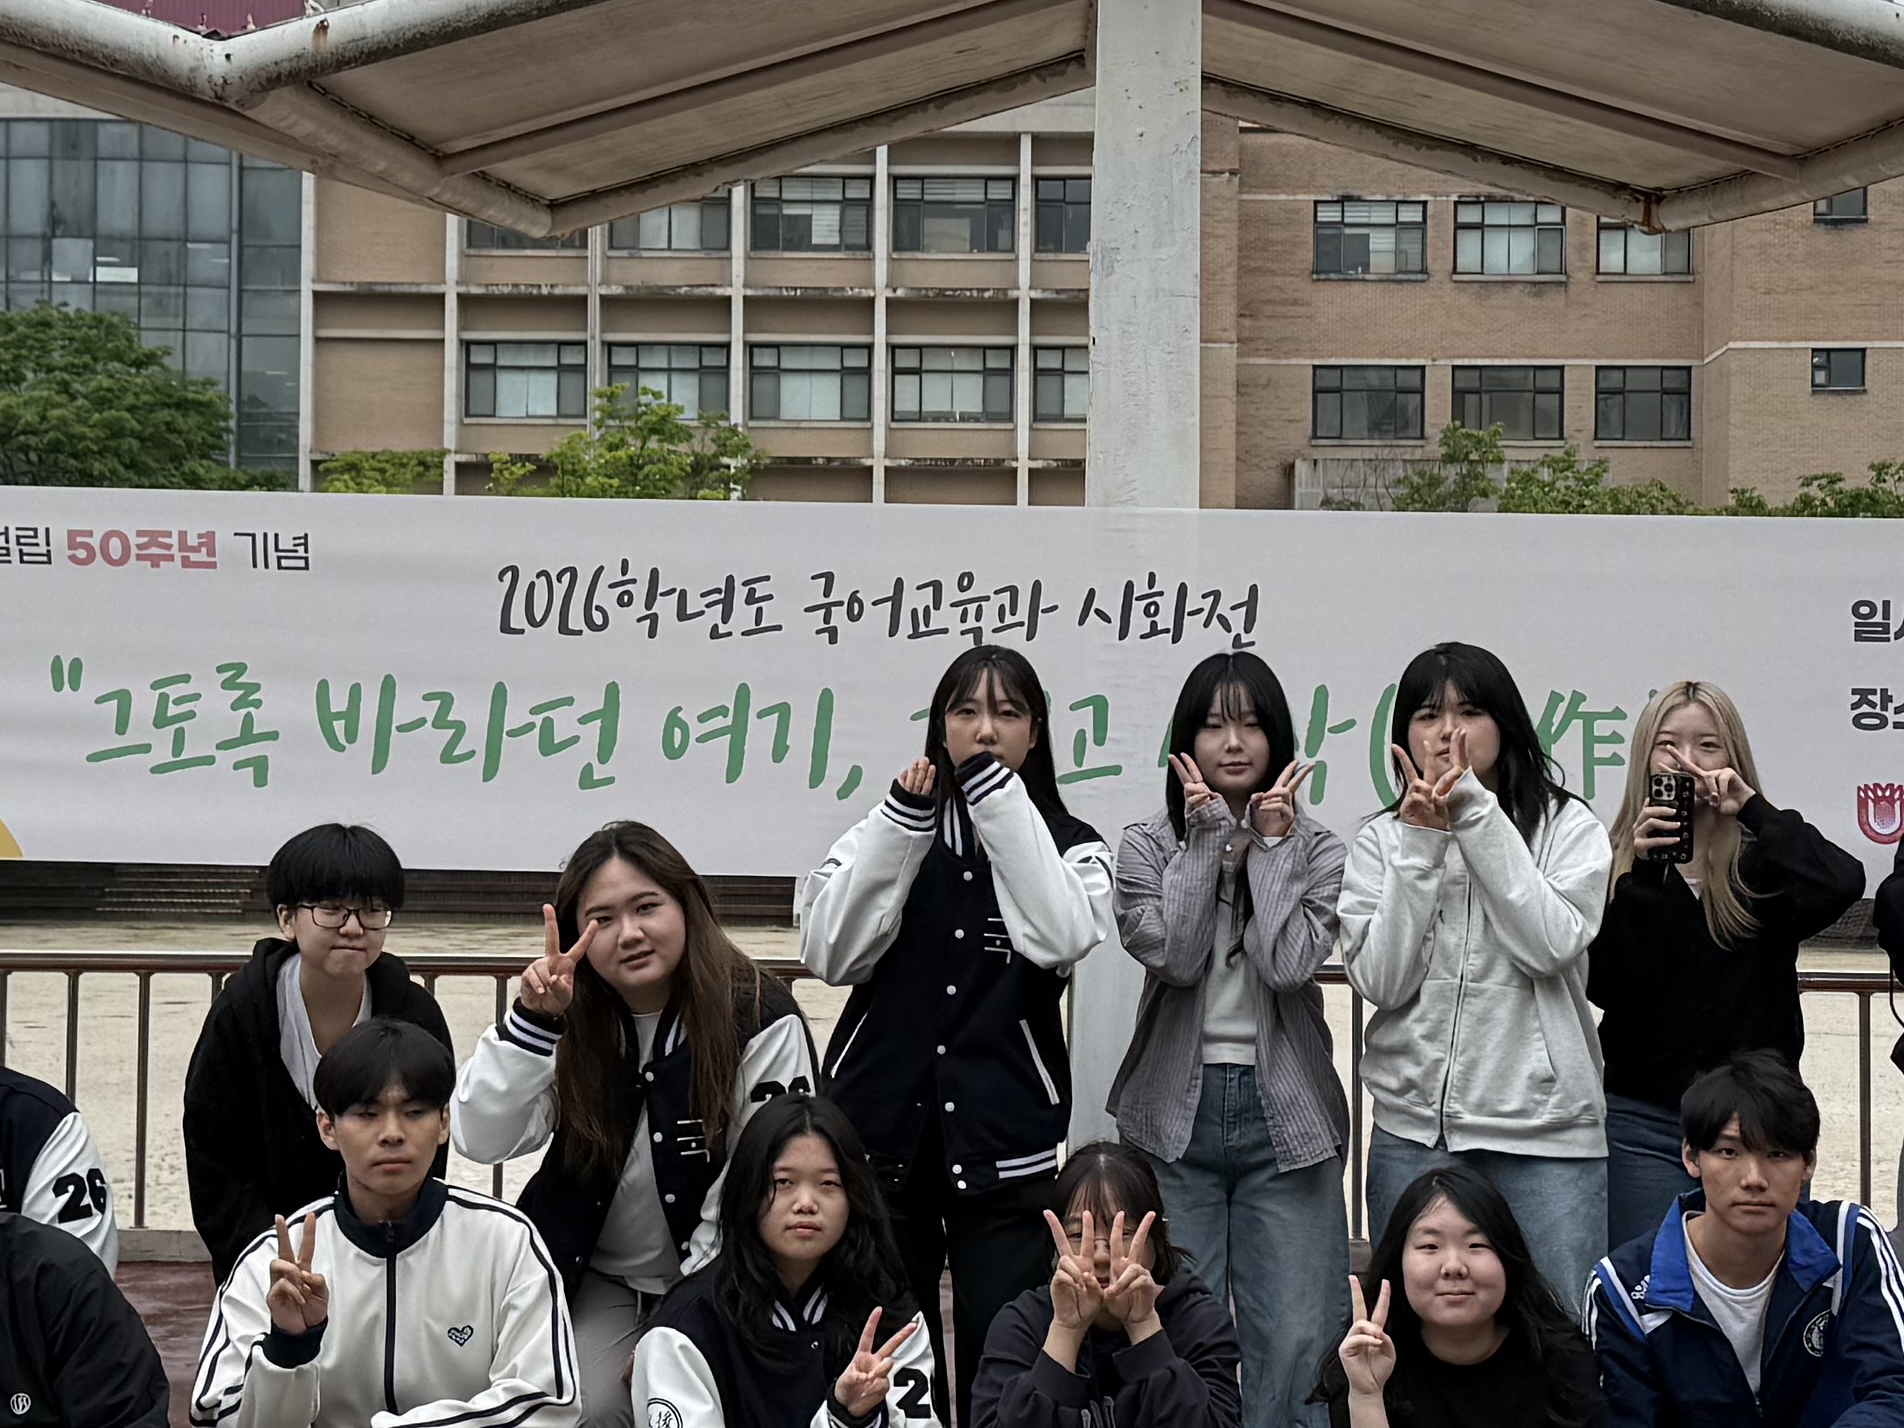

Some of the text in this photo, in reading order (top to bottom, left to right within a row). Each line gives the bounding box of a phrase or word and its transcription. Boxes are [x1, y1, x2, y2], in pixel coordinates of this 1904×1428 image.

[66, 529, 218, 570] 50주년
[233, 531, 310, 571] 기념
[497, 557, 1259, 650] 2026학년도 국어교육과 시화전
[315, 673, 621, 790] 바라던
[662, 682, 863, 801] 여기,
[52, 1168, 108, 1224] 26
[893, 1367, 935, 1419] 2
